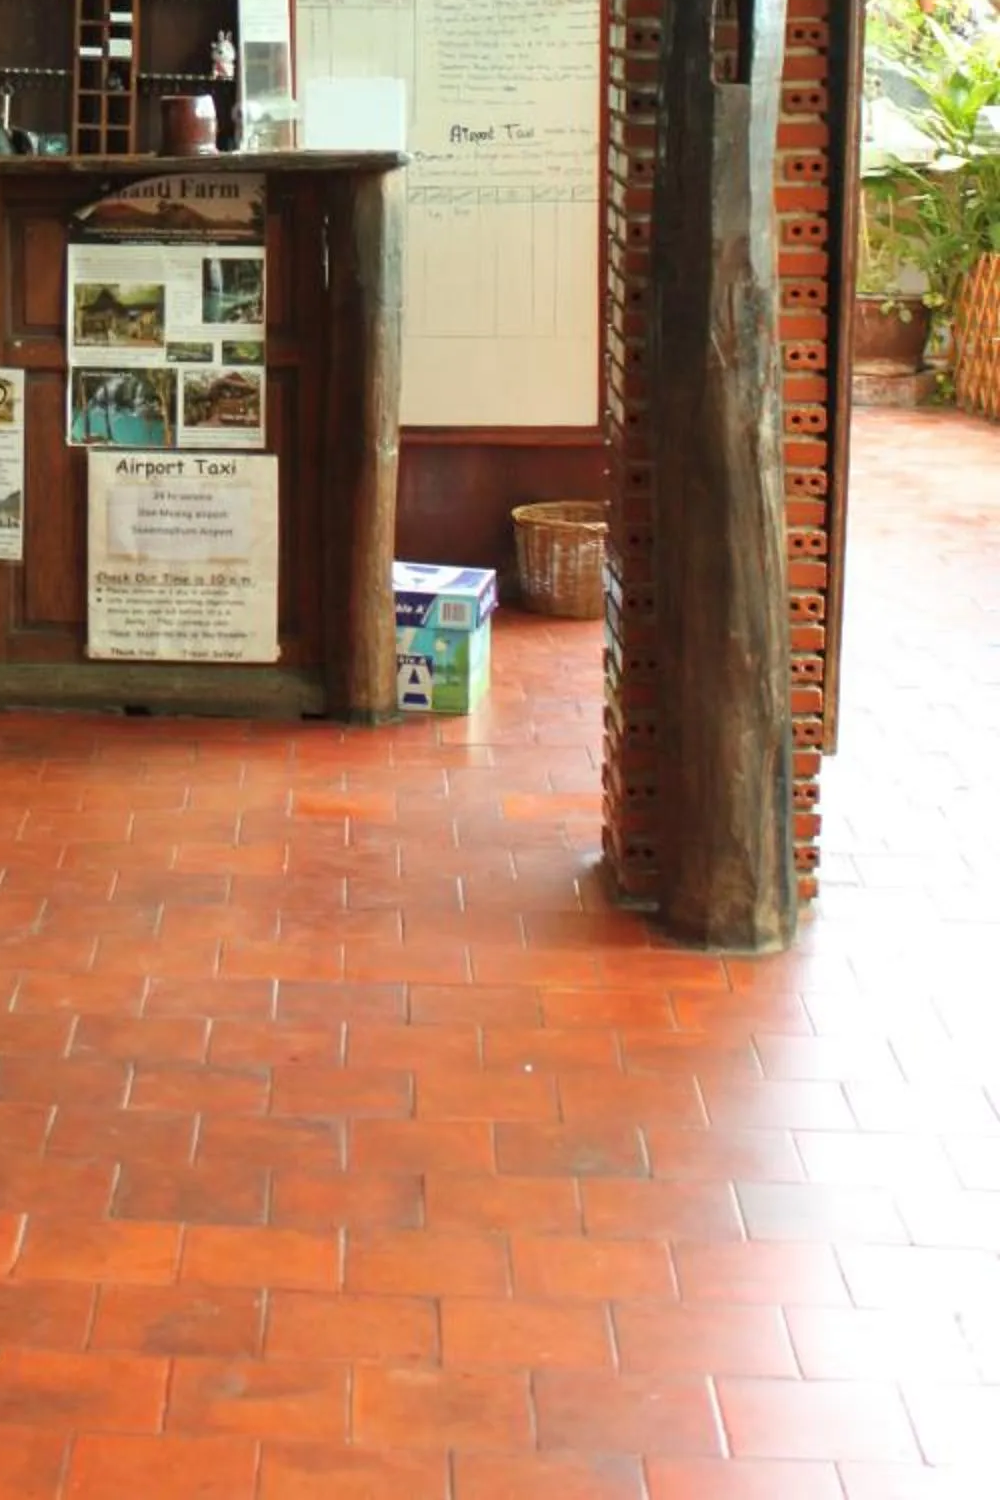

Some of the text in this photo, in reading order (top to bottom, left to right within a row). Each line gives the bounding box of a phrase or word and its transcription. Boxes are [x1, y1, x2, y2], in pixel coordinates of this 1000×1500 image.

[180, 179, 240, 199] Farm
[116, 458, 237, 478] Airport Taxi
